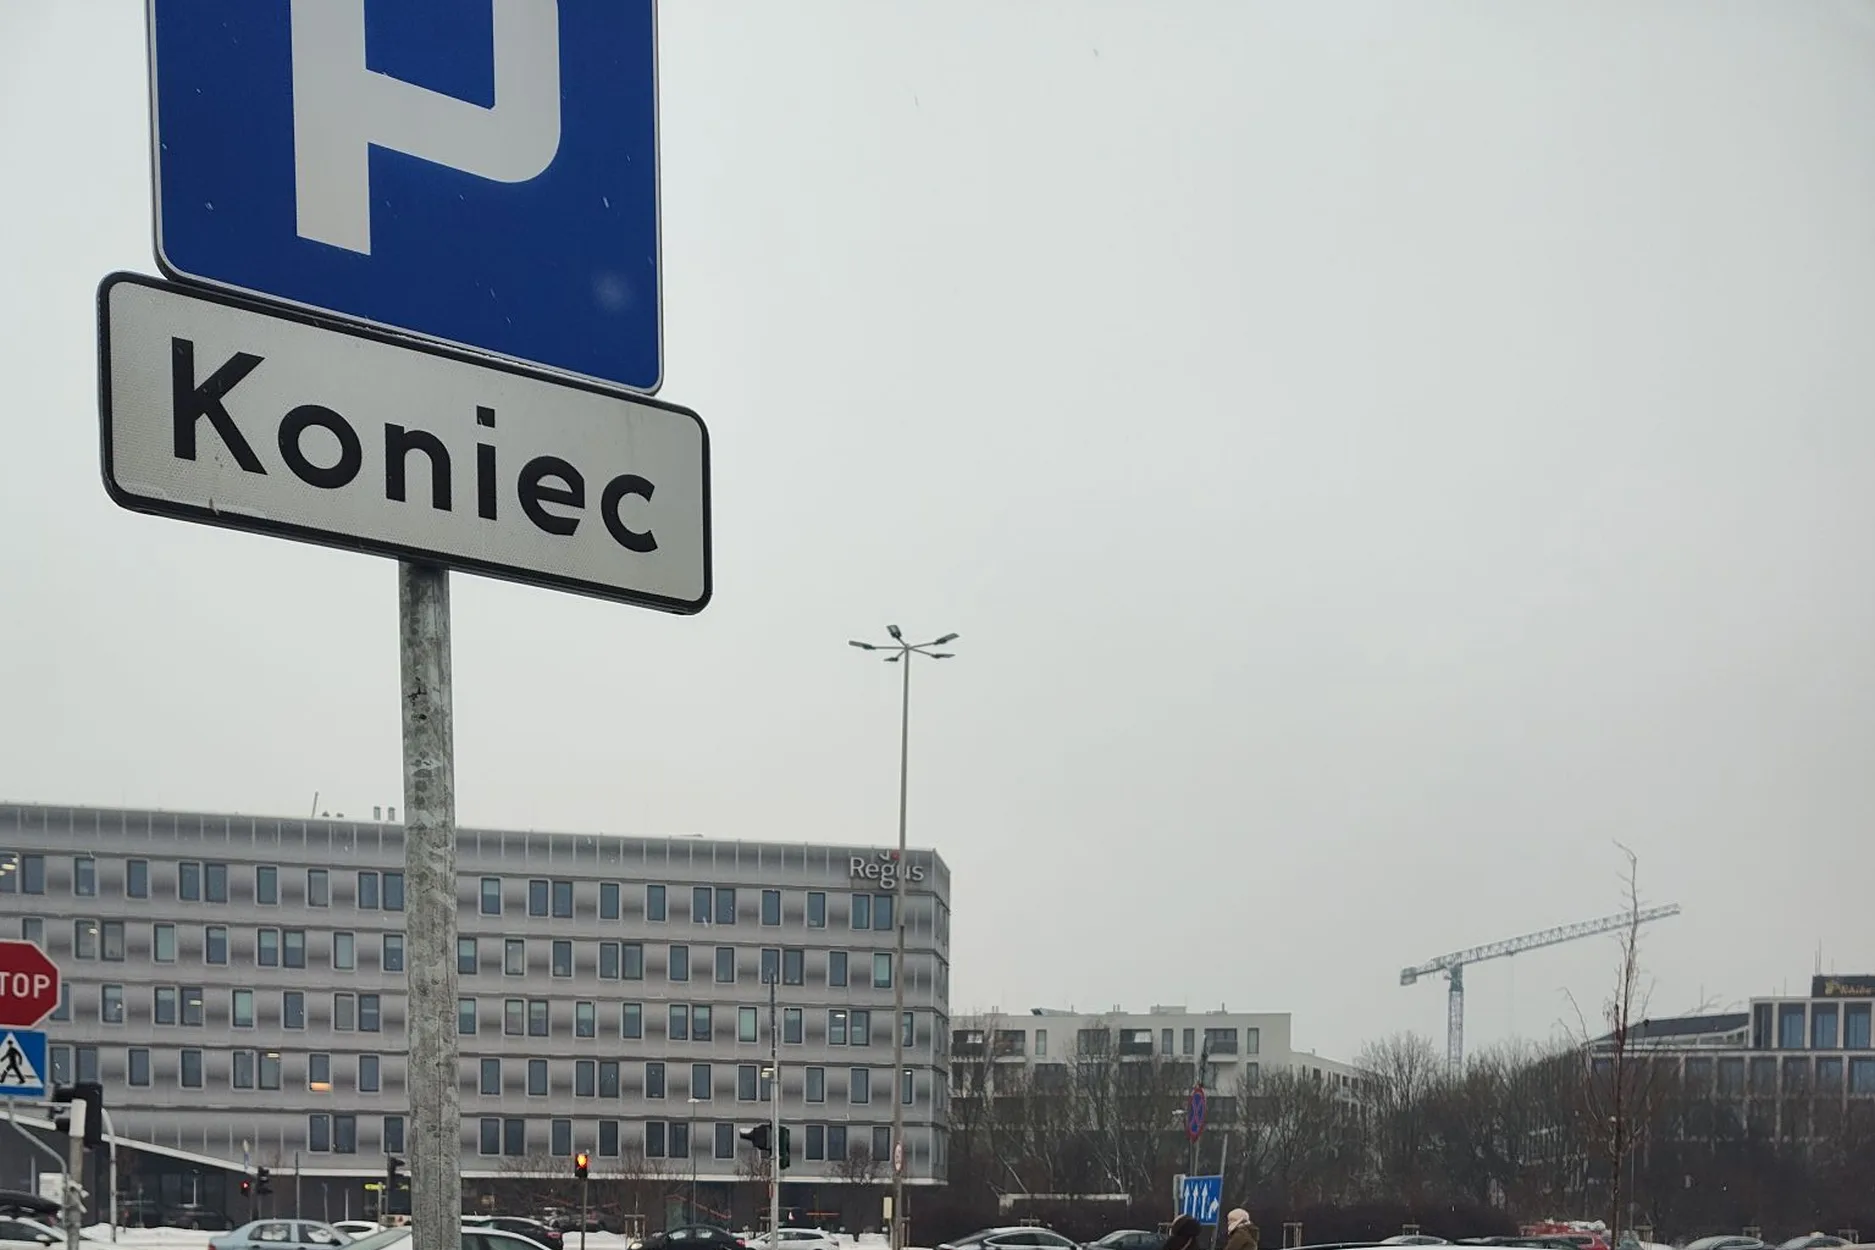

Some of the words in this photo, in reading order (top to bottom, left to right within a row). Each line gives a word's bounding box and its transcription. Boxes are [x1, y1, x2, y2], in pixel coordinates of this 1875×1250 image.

[291, 0, 561, 255] P
[172, 337, 658, 553] Koniec
[850, 856, 924, 889] Regus
[0, 971, 51, 999] TOP
